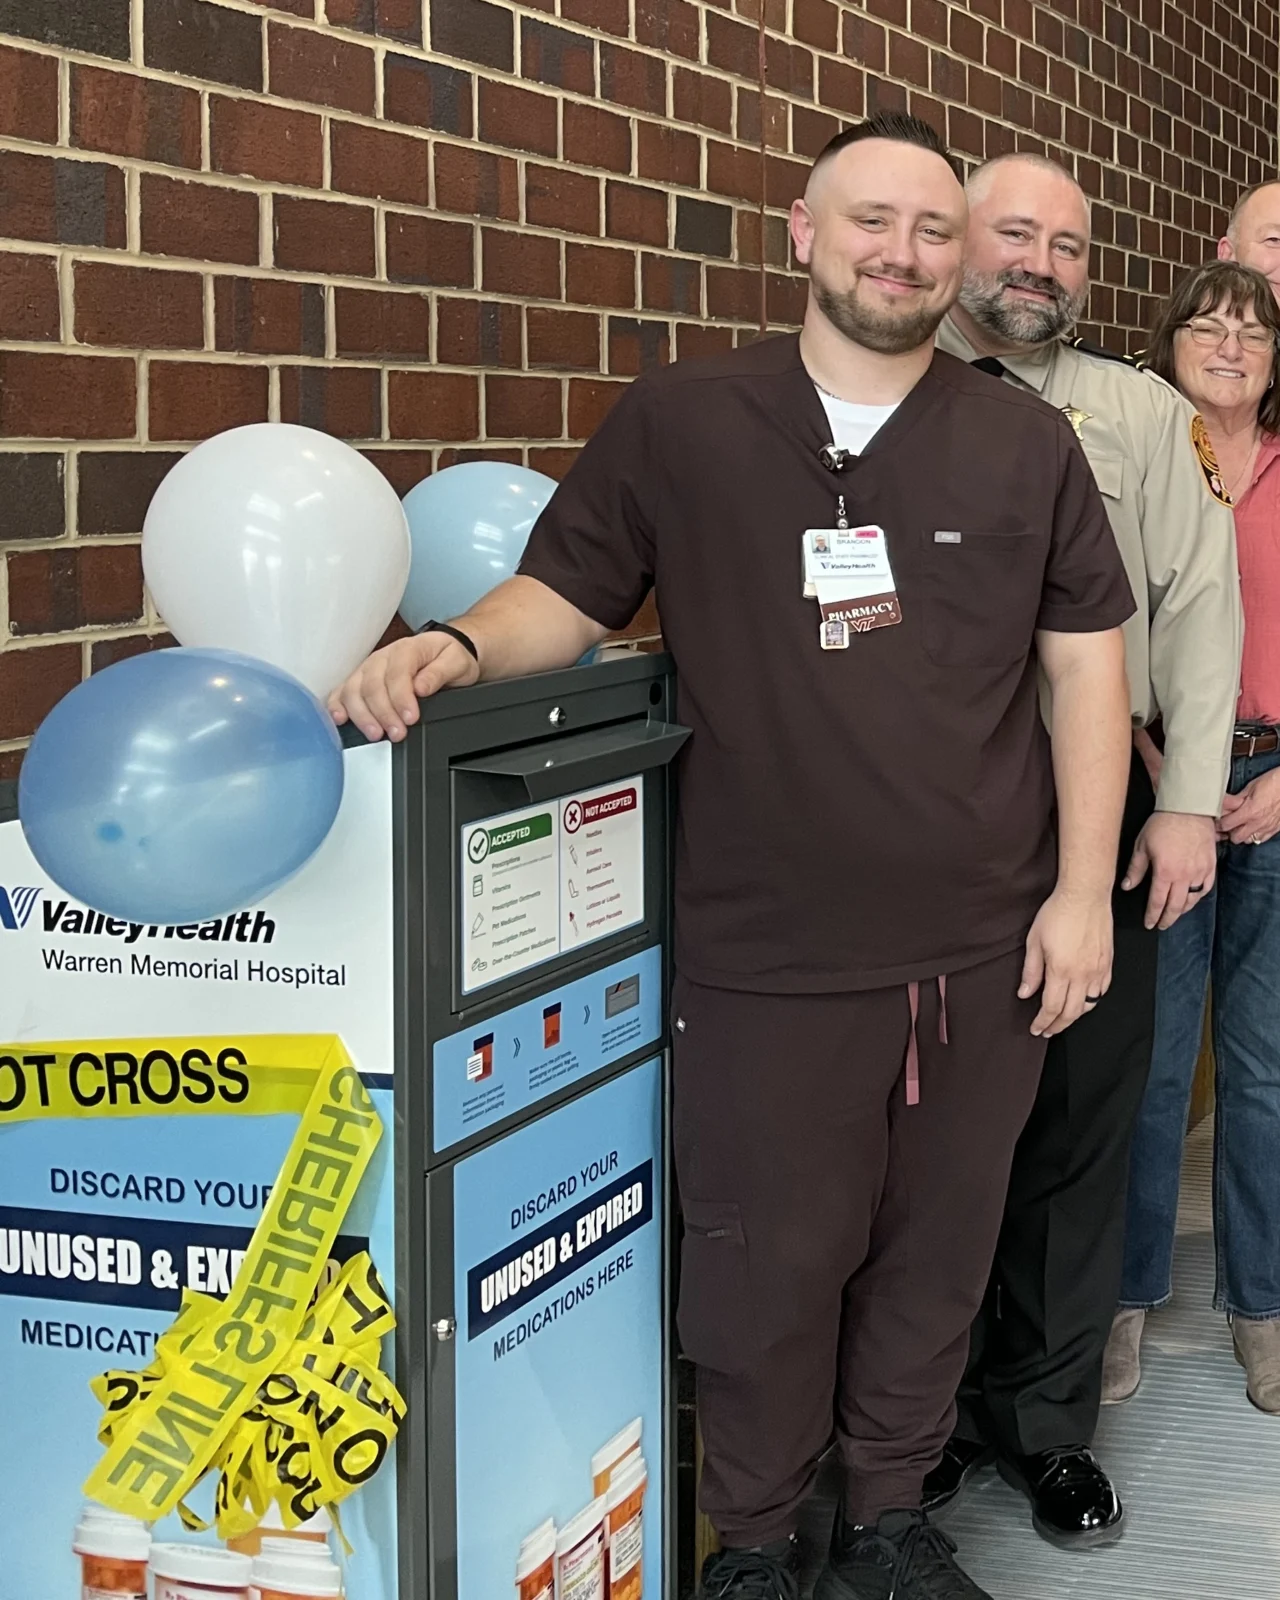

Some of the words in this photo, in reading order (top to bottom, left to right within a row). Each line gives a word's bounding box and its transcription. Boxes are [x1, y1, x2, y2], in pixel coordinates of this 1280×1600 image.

[828, 601, 894, 621] PHARMACY
[585, 805, 599, 818] NOT
[600, 795, 633, 814] ACCEPTED
[491, 826, 531, 847] ACCEPTED
[42, 949, 122, 974] Warren
[131, 953, 239, 981] Memorial
[247, 960, 346, 989] Hospital
[69, 1047, 250, 1108] CROSS
[51, 1168, 186, 1204] DISCARD
[511, 1176, 577, 1230] DISCARD
[580, 1150, 619, 1188] YOUR
[0, 1229, 141, 1286] UNUSED
[151, 1250, 179, 1288] &
[480, 1236, 557, 1314] UNUSED
[559, 1231, 574, 1264] &
[576, 1181, 643, 1252] EXPIRED
[493, 1277, 595, 1362] MEDICATIONS
[598, 1249, 634, 1290] HERE
[21, 1319, 158, 1357] MEDICAT
